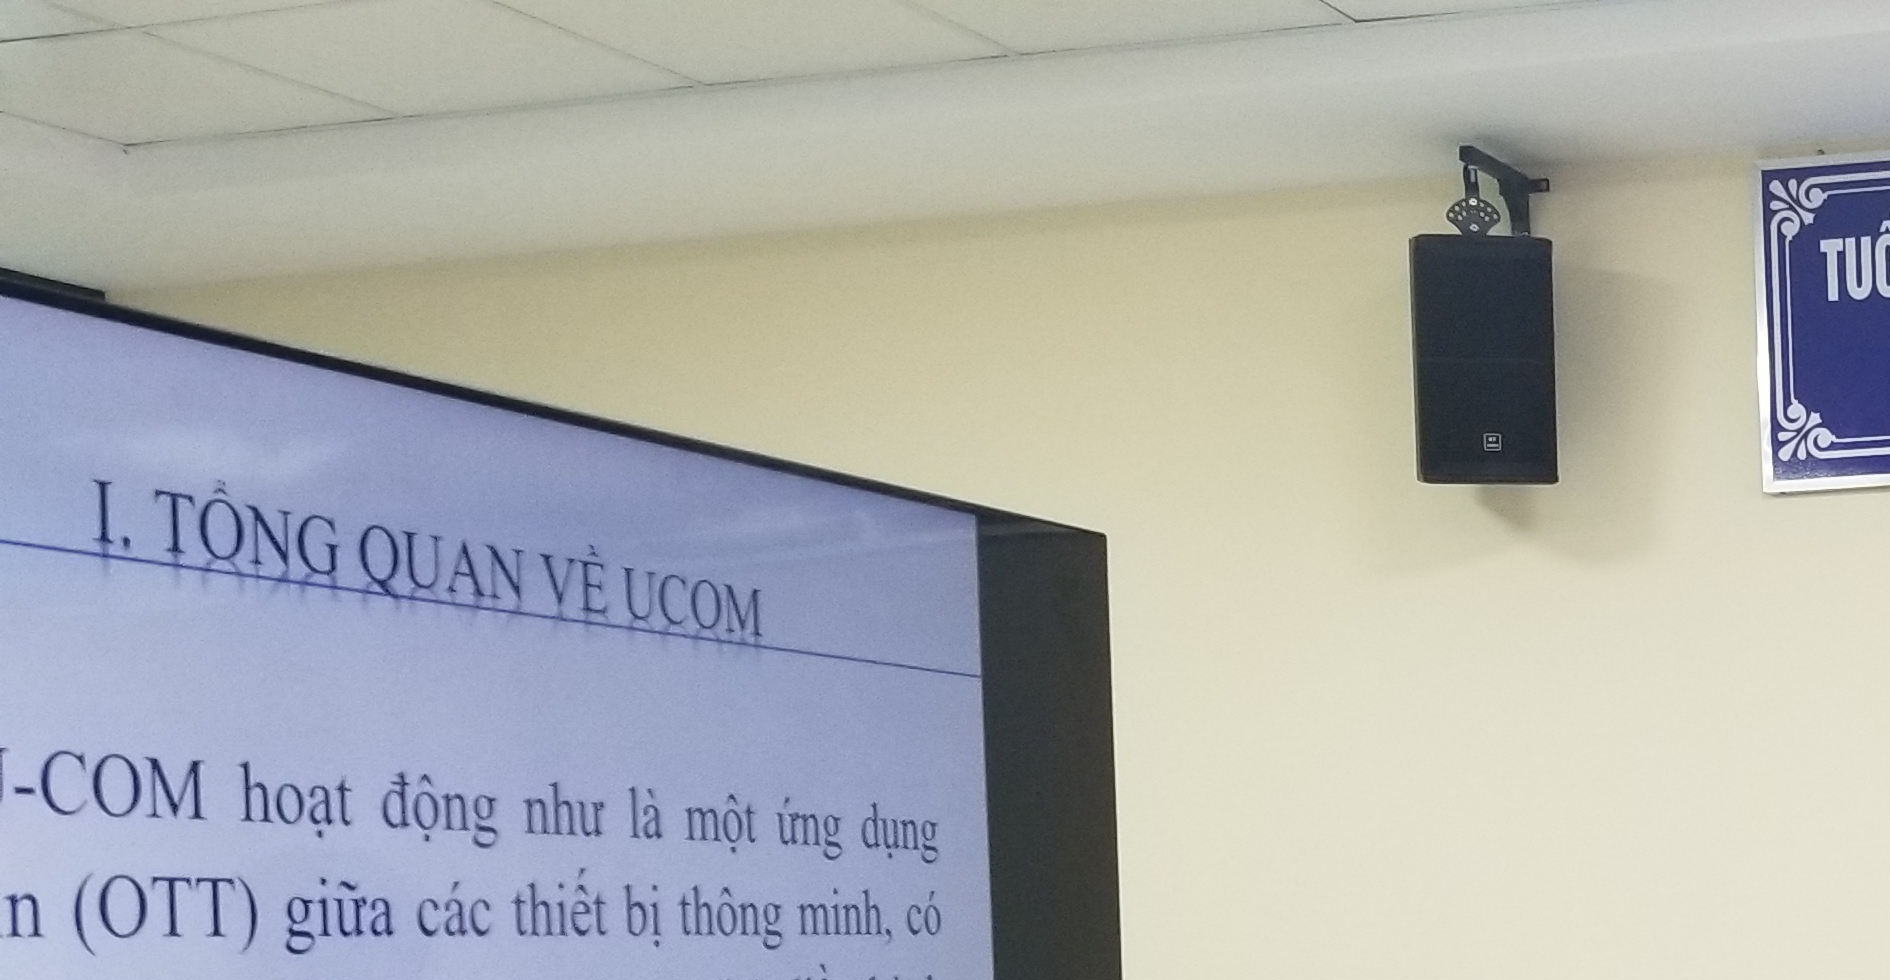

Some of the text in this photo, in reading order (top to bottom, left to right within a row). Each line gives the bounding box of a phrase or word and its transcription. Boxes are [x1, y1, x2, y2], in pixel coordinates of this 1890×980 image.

[92, 478, 763, 638] I. TỔNG QUAN VỀ UCOM
[0, 748, 938, 864] -COM hoạt động như là một ứng dụng
[73, 874, 258, 956] (OTT)
[285, 877, 394, 955] giữa
[417, 881, 490, 937] các
[511, 868, 607, 937] thiết
[624, 884, 661, 947] bị
[678, 885, 782, 950] thông
[797, 888, 892, 939] minh,
[907, 891, 941, 935] có
